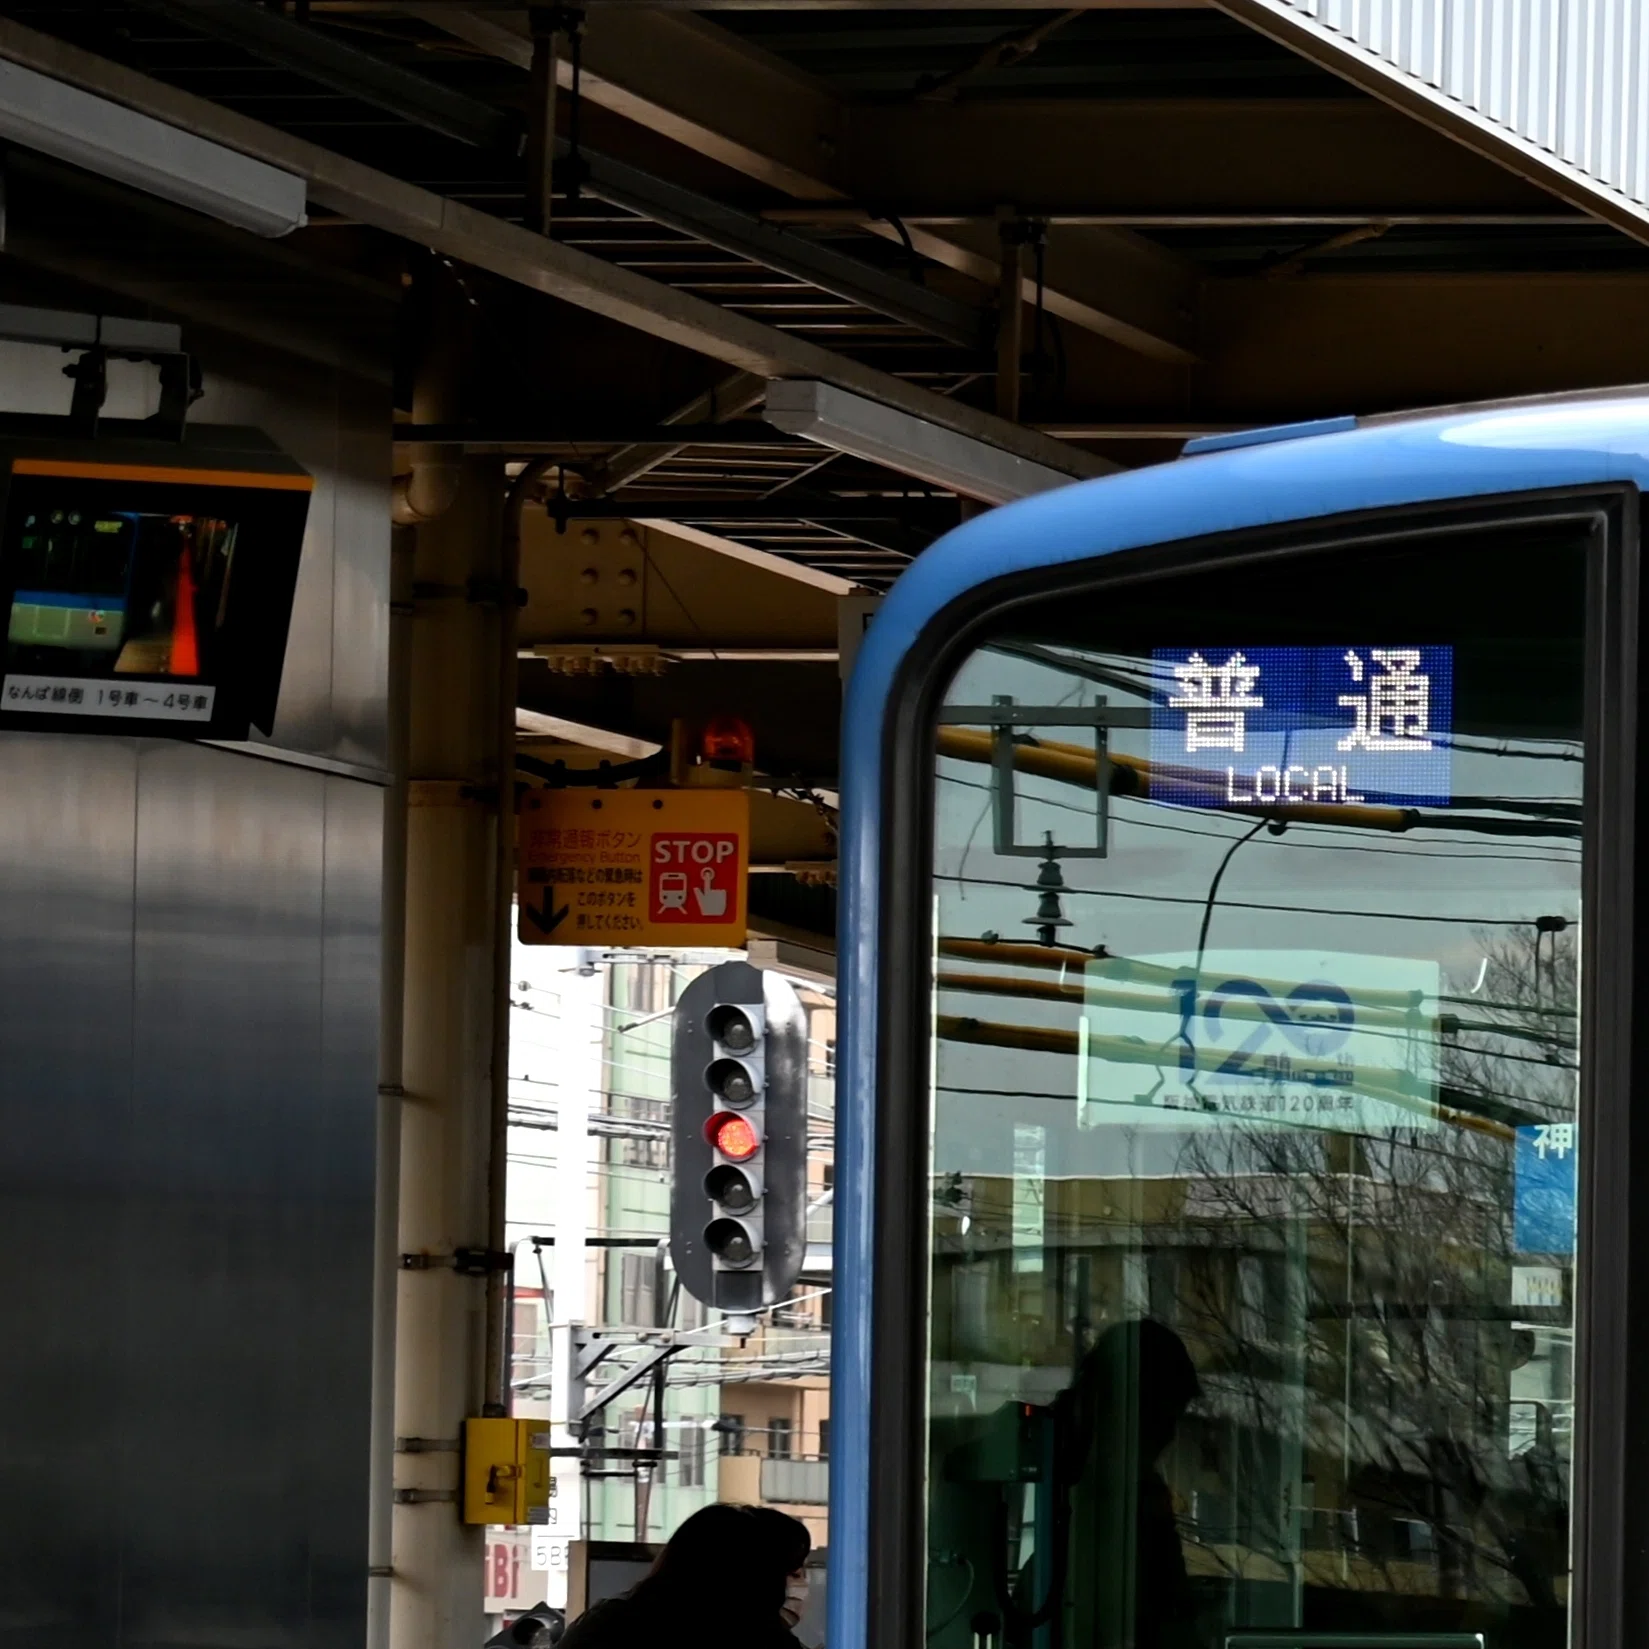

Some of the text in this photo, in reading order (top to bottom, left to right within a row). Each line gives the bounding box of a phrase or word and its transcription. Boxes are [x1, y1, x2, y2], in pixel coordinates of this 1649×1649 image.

[8, 685, 85, 705] なんば線側
[1168, 650, 1433, 753] 普通
[1227, 765, 1366, 804] LOCAL
[528, 851, 641, 865] Emergency Button
[654, 840, 735, 864] STOP
[577, 891, 636, 908] このボタンを
